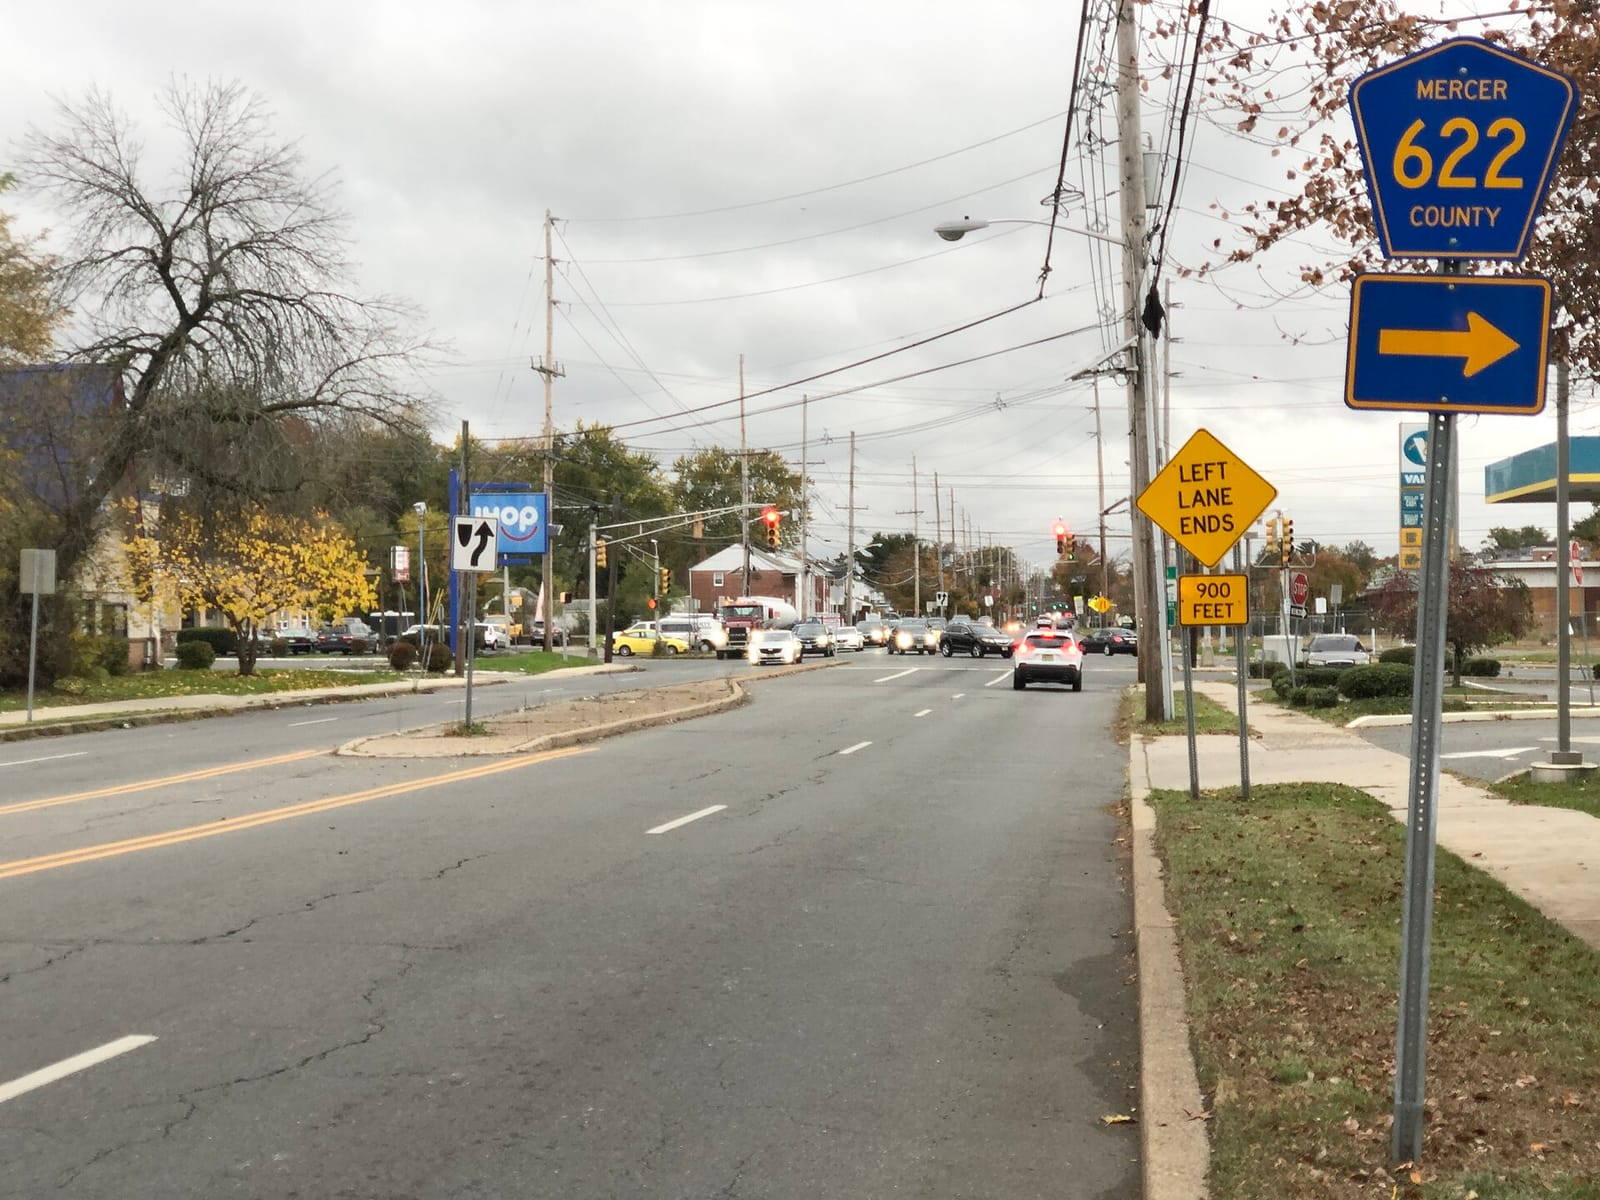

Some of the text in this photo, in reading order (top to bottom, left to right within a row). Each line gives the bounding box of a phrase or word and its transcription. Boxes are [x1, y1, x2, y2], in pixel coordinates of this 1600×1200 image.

[1416, 79, 1508, 101] MERCER
[1393, 117, 1527, 190] 622
[1409, 206, 1501, 228] COUNTY
[1179, 461, 1228, 483] LEFT
[1178, 487, 1234, 510] LANE
[1180, 514, 1235, 536] ENDS
[1196, 582, 1231, 599] 900
[1294, 583, 1307, 596] STOP
[1193, 603, 1234, 619] FEET
